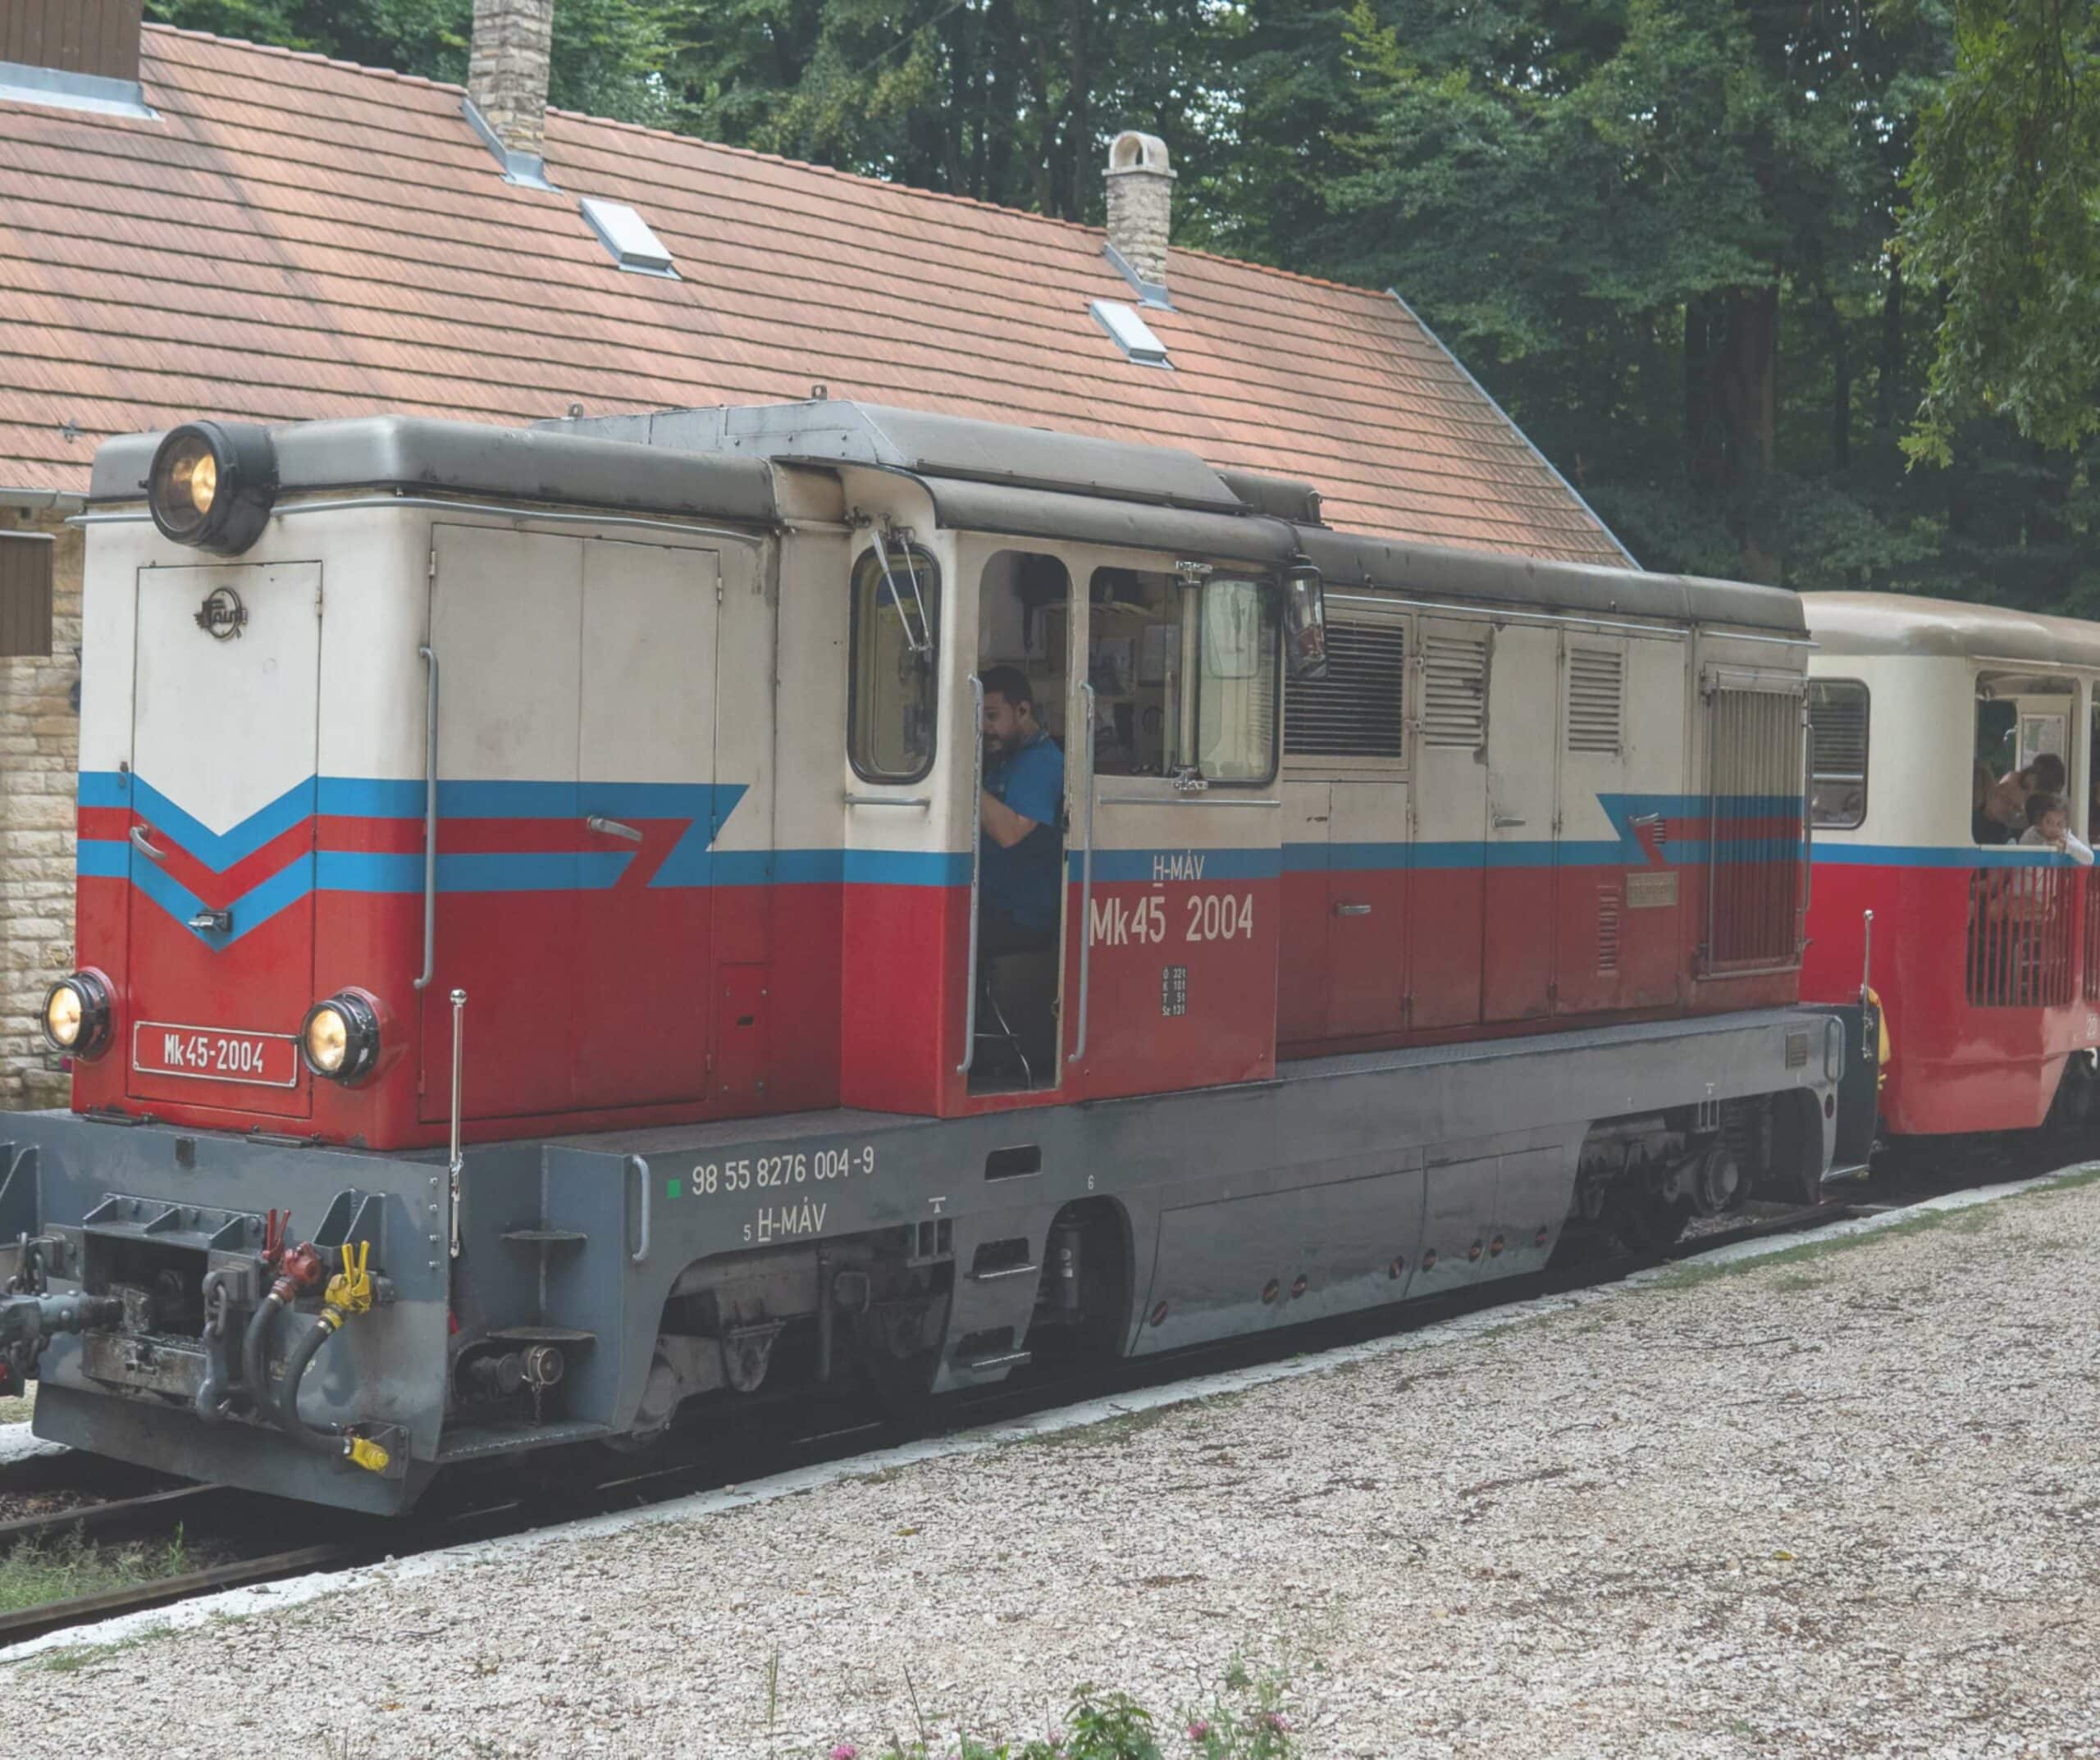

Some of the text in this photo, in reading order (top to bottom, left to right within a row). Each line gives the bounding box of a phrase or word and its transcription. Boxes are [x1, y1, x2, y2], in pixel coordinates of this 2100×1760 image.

[1153, 849, 1205, 887] H-MÁV
[1090, 893, 1253, 946] Mk45 2004
[164, 1033, 263, 1074] Mk45-2004
[692, 1165, 718, 1196] 98
[724, 1159, 751, 1191] 55
[756, 1153, 807, 1188] 8276
[1088, 1174, 1095, 1190] 6
[743, 1224, 752, 1242] 5
[757, 1196, 827, 1242] H-MÁV
